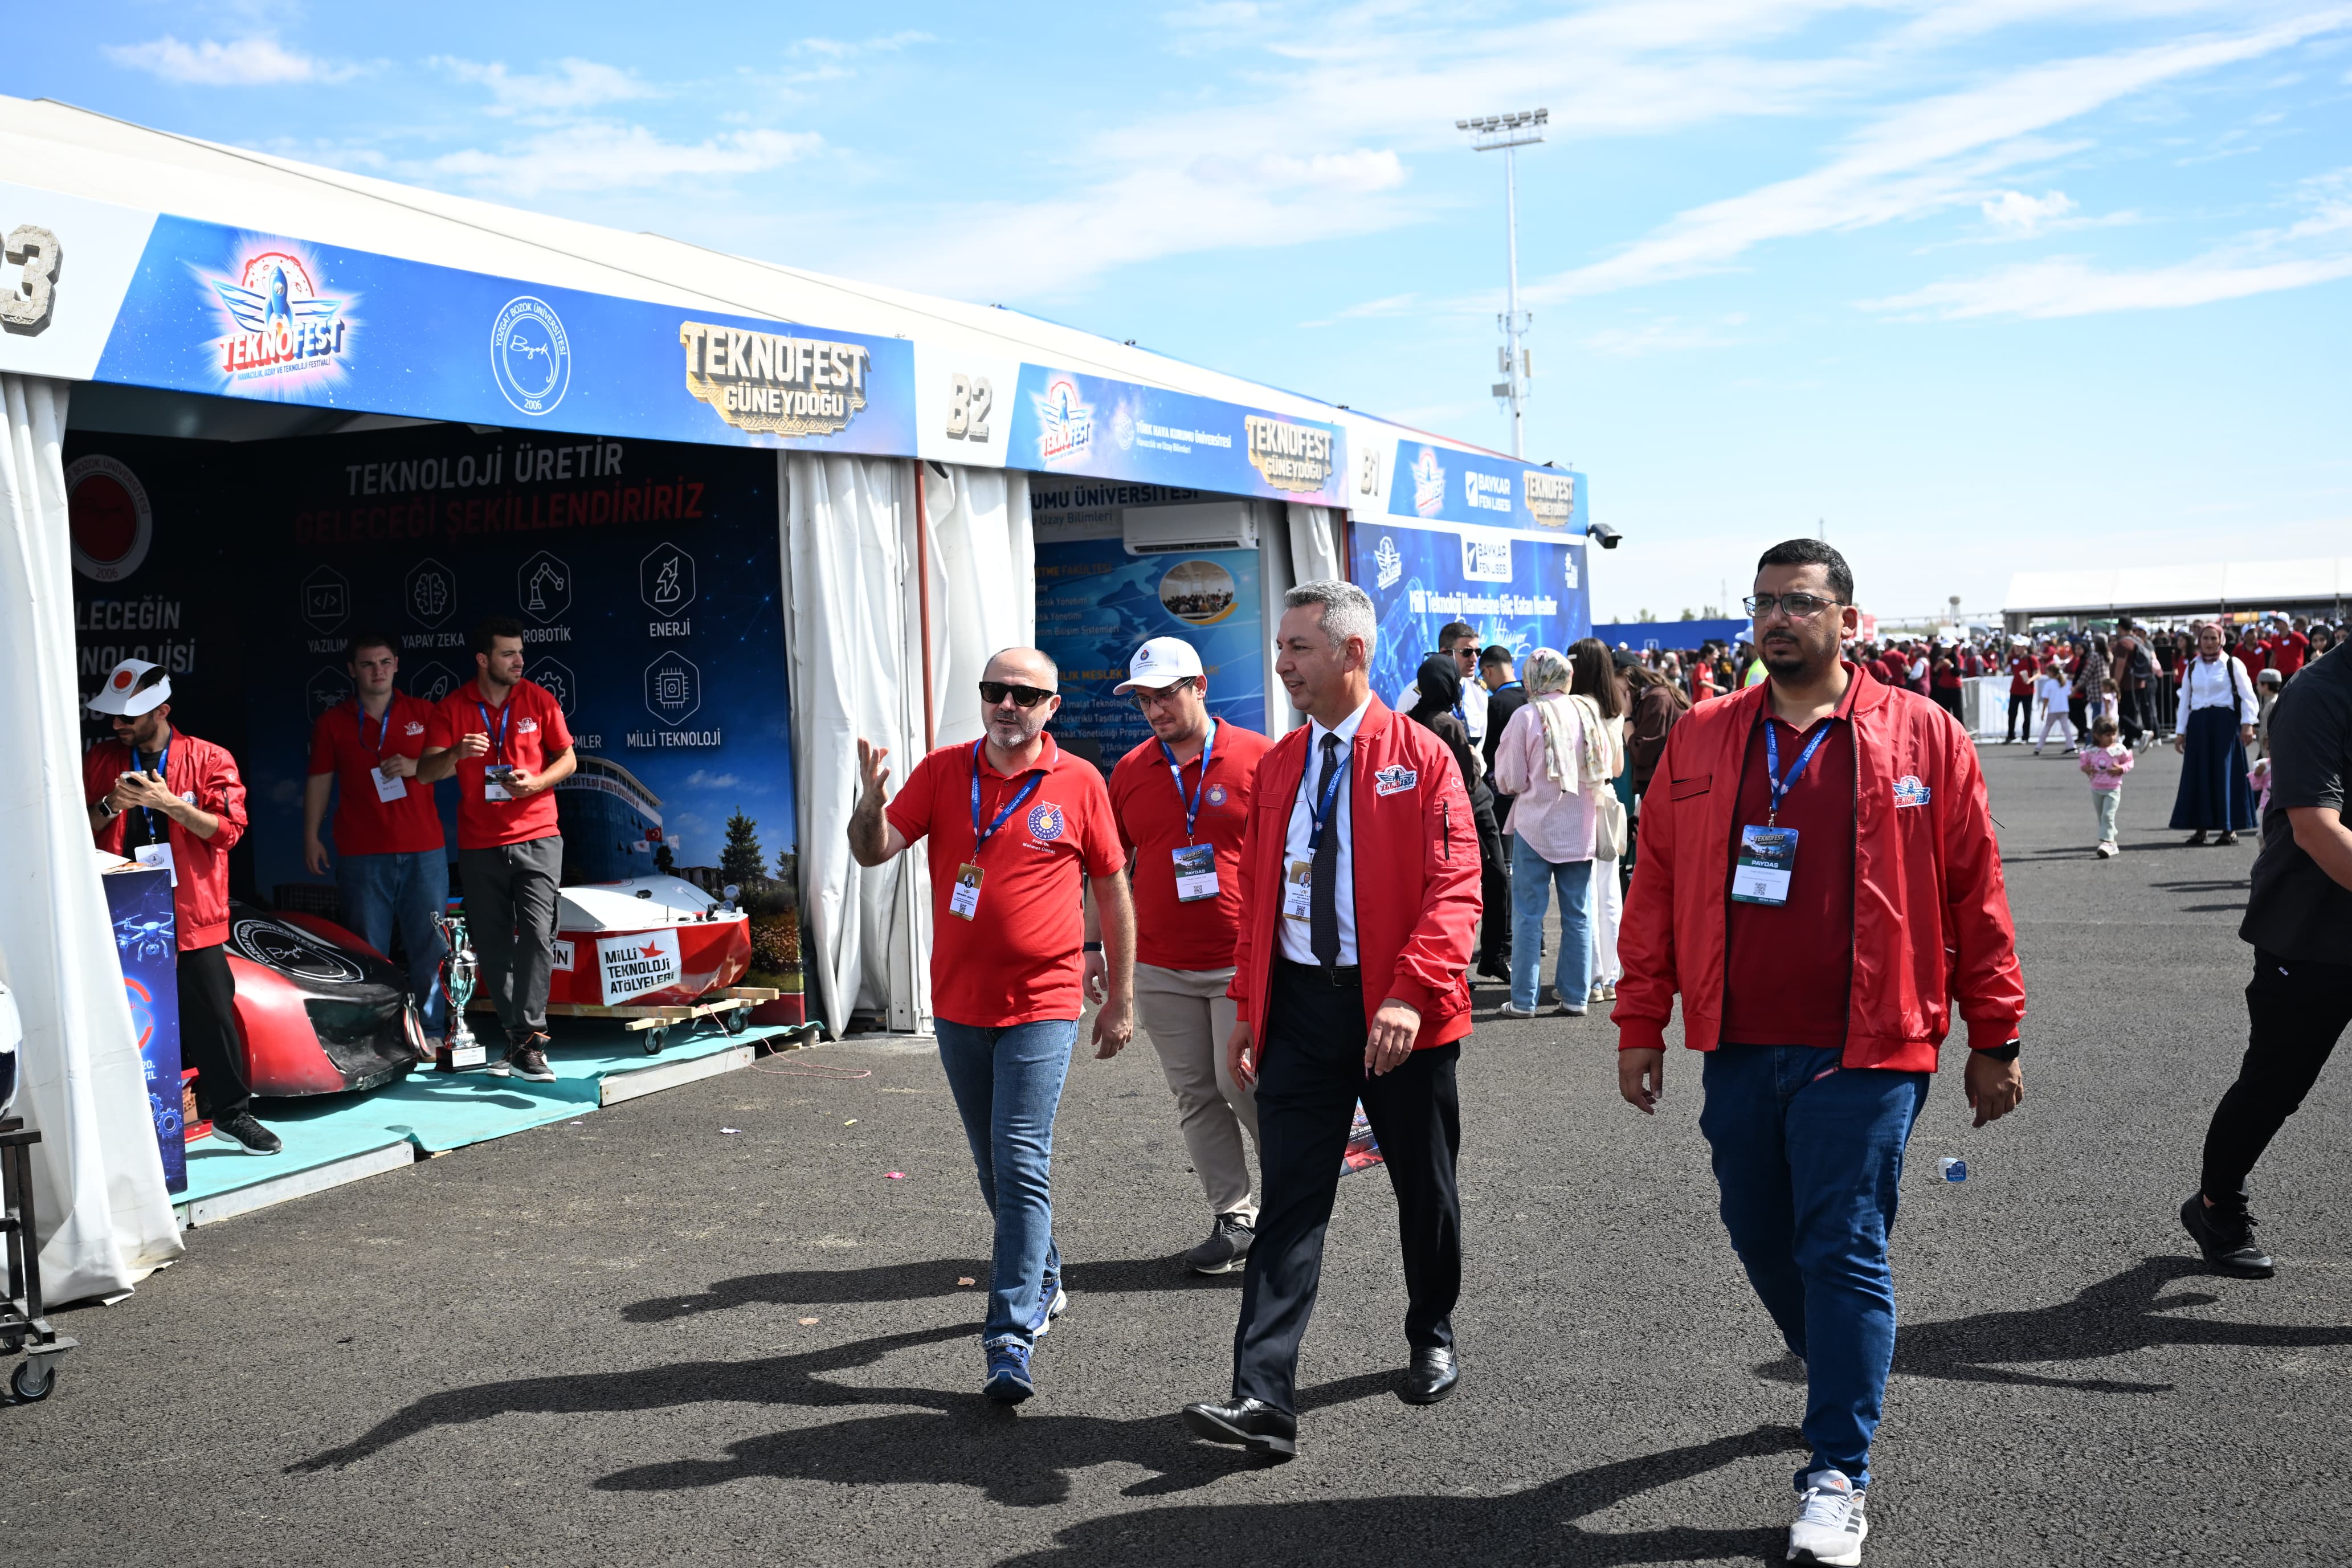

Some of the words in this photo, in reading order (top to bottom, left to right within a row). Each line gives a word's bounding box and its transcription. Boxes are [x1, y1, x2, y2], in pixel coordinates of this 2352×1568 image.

[0, 224, 63, 337] 3
[495, 313, 511, 346] YOZGAT
[509, 303, 532, 317] BOZOK
[533, 303, 567, 355] ÜNİVERSİTESİ
[219, 318, 345, 373] TEKNOFEST
[684, 329, 865, 388] TEKNOFEST
[264, 368, 276, 376] UZAY
[276, 366, 283, 374] VE
[524, 398, 542, 410] 2006
[724, 382, 844, 416] GÜNEYDOĞU
[946, 371, 992, 443] B2
[1136, 420, 1153, 435] TÜRK
[1153, 425, 1169, 438] HAVA
[1170, 428, 1195, 442] KURUMU
[1246, 418, 1333, 460] TEKNOFEST
[346, 445, 503, 496] TEKNOLOJİ
[515, 436, 623, 483] ÜRETİR
[1267, 454, 1323, 479] GÜNEYDOĞU
[1361, 447, 1380, 496] B1
[1478, 473, 1510, 495] BAYKAR
[1032, 491, 1069, 509] UMU
[1479, 495, 1492, 509] FEN
[295, 495, 435, 543] GELECEĞİ
[446, 476, 705, 544] ŞEKİLLENDİRİRİZ
[1040, 515, 1064, 526] Uzay
[1067, 510, 1113, 524] Bilimleri
[1478, 543, 1506, 557] BAYKAR
[96, 568, 119, 579] 2006
[1035, 565, 1060, 578] ETME
[1479, 562, 1491, 574] FEN
[1056, 597, 1088, 607] Yönetimi
[1410, 590, 1426, 613] Milli
[1426, 591, 1462, 616] Teknoloji
[1462, 592, 1500, 615] Hamlesine
[1500, 594, 1514, 620] Güç
[1514, 594, 1533, 615] Katan
[1533, 595, 1558, 616] Nesiller
[75, 595, 181, 630] LECEĞİN
[1050, 611, 1083, 622] Yönetimi
[523, 624, 571, 643] ROBOTİK
[650, 617, 691, 638] ENERJİ
[1081, 624, 1120, 634] Sistemleri
[402, 635, 434, 649] YAPAY
[434, 633, 465, 647] ZEKA
[1083, 668, 1124, 680] MESLEK
[1060, 714, 1093, 724] Elektrikli
[1124, 712, 1147, 722] Tekno
[627, 729, 656, 748] MİLLİ
[659, 728, 721, 746] TEKNOLOJİ
[1078, 729, 1115, 740] Yöneticiliği
[1804, 729, 1827, 762] TEKNOFEST
[1329, 763, 1345, 797] TEKNOFEST
[1380, 777, 1414, 792] TEKNOFEST
[1022, 842, 1040, 851] Mehmet
[1181, 850, 1203, 860] TEKNOFEST
